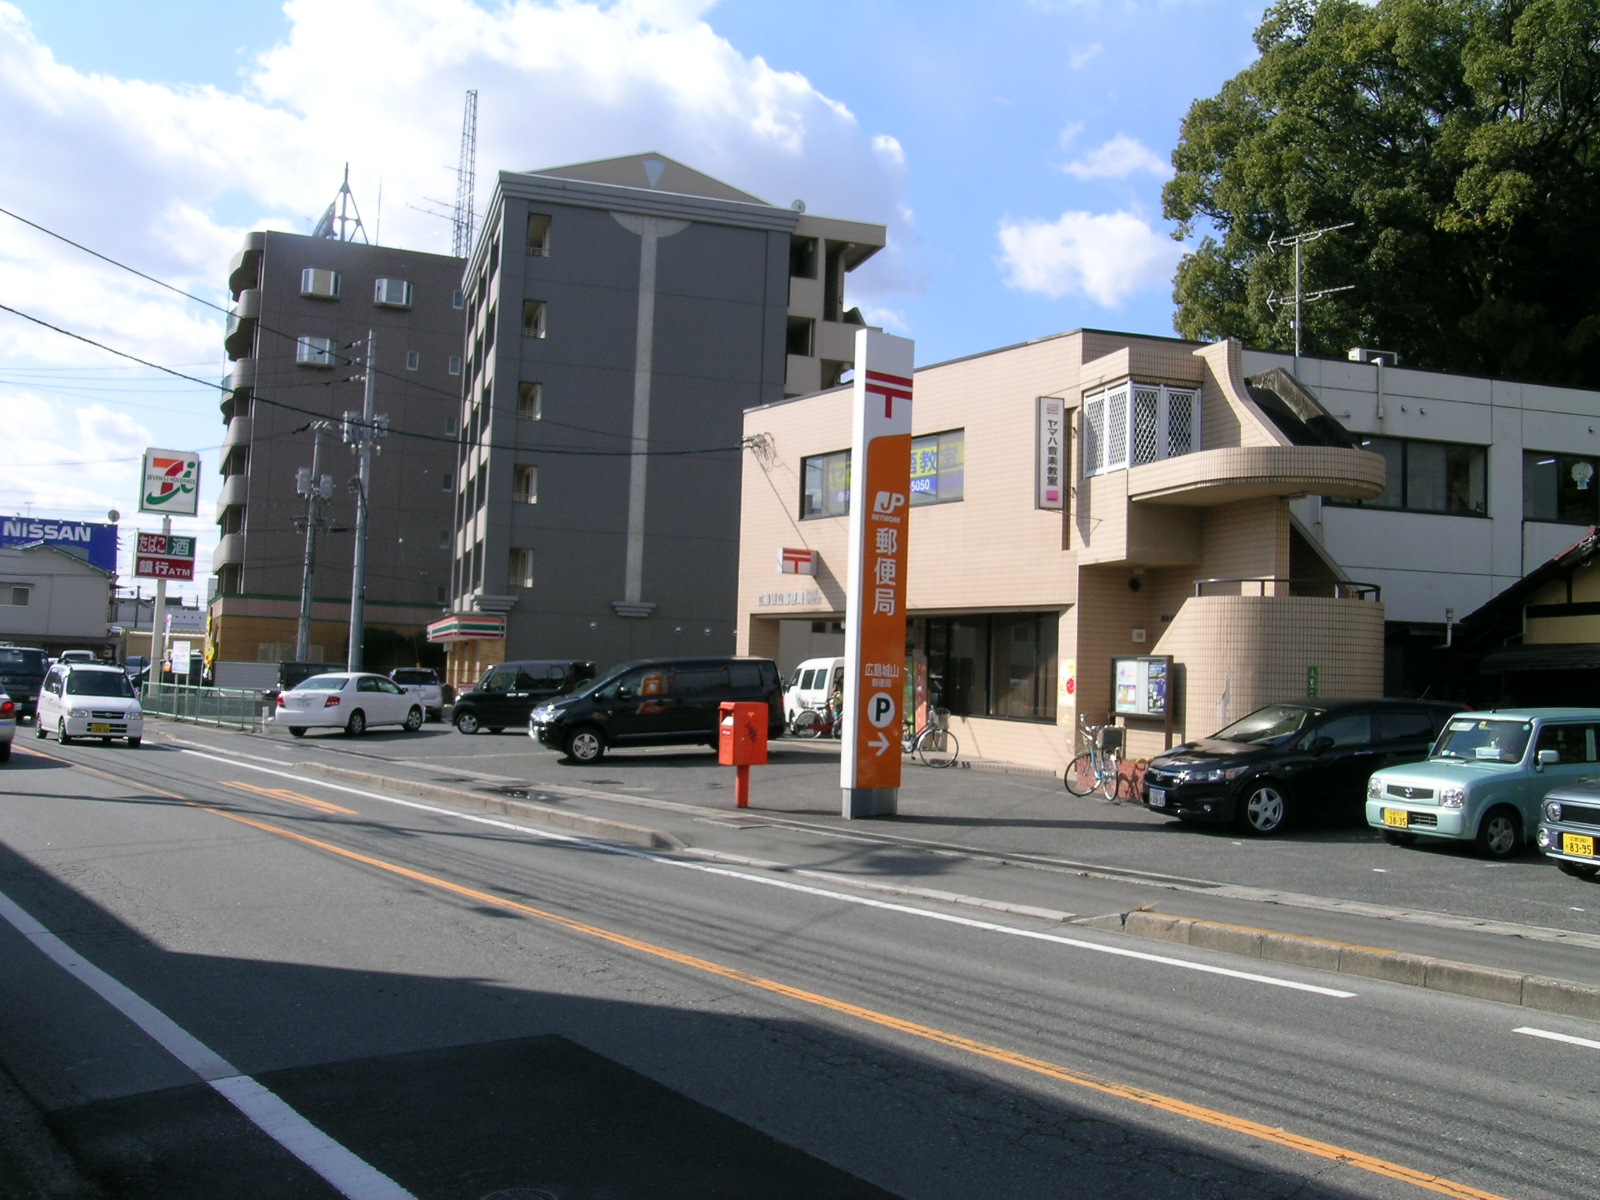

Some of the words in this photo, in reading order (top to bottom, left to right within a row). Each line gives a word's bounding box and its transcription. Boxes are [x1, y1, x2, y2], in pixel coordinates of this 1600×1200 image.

[1047, 419, 1059, 487] ヤマハ音楽教室
[871, 513, 902, 524] NETWORK
[3, 521, 92, 542] NISSAN
[139, 535, 166, 553] たばこ
[171, 537, 190, 556] 酒
[873, 527, 898, 617] 郵便局
[865, 662, 900, 678] 広島城山
[875, 698, 891, 722] P
[1569, 842, 1592, 855] 83-95
